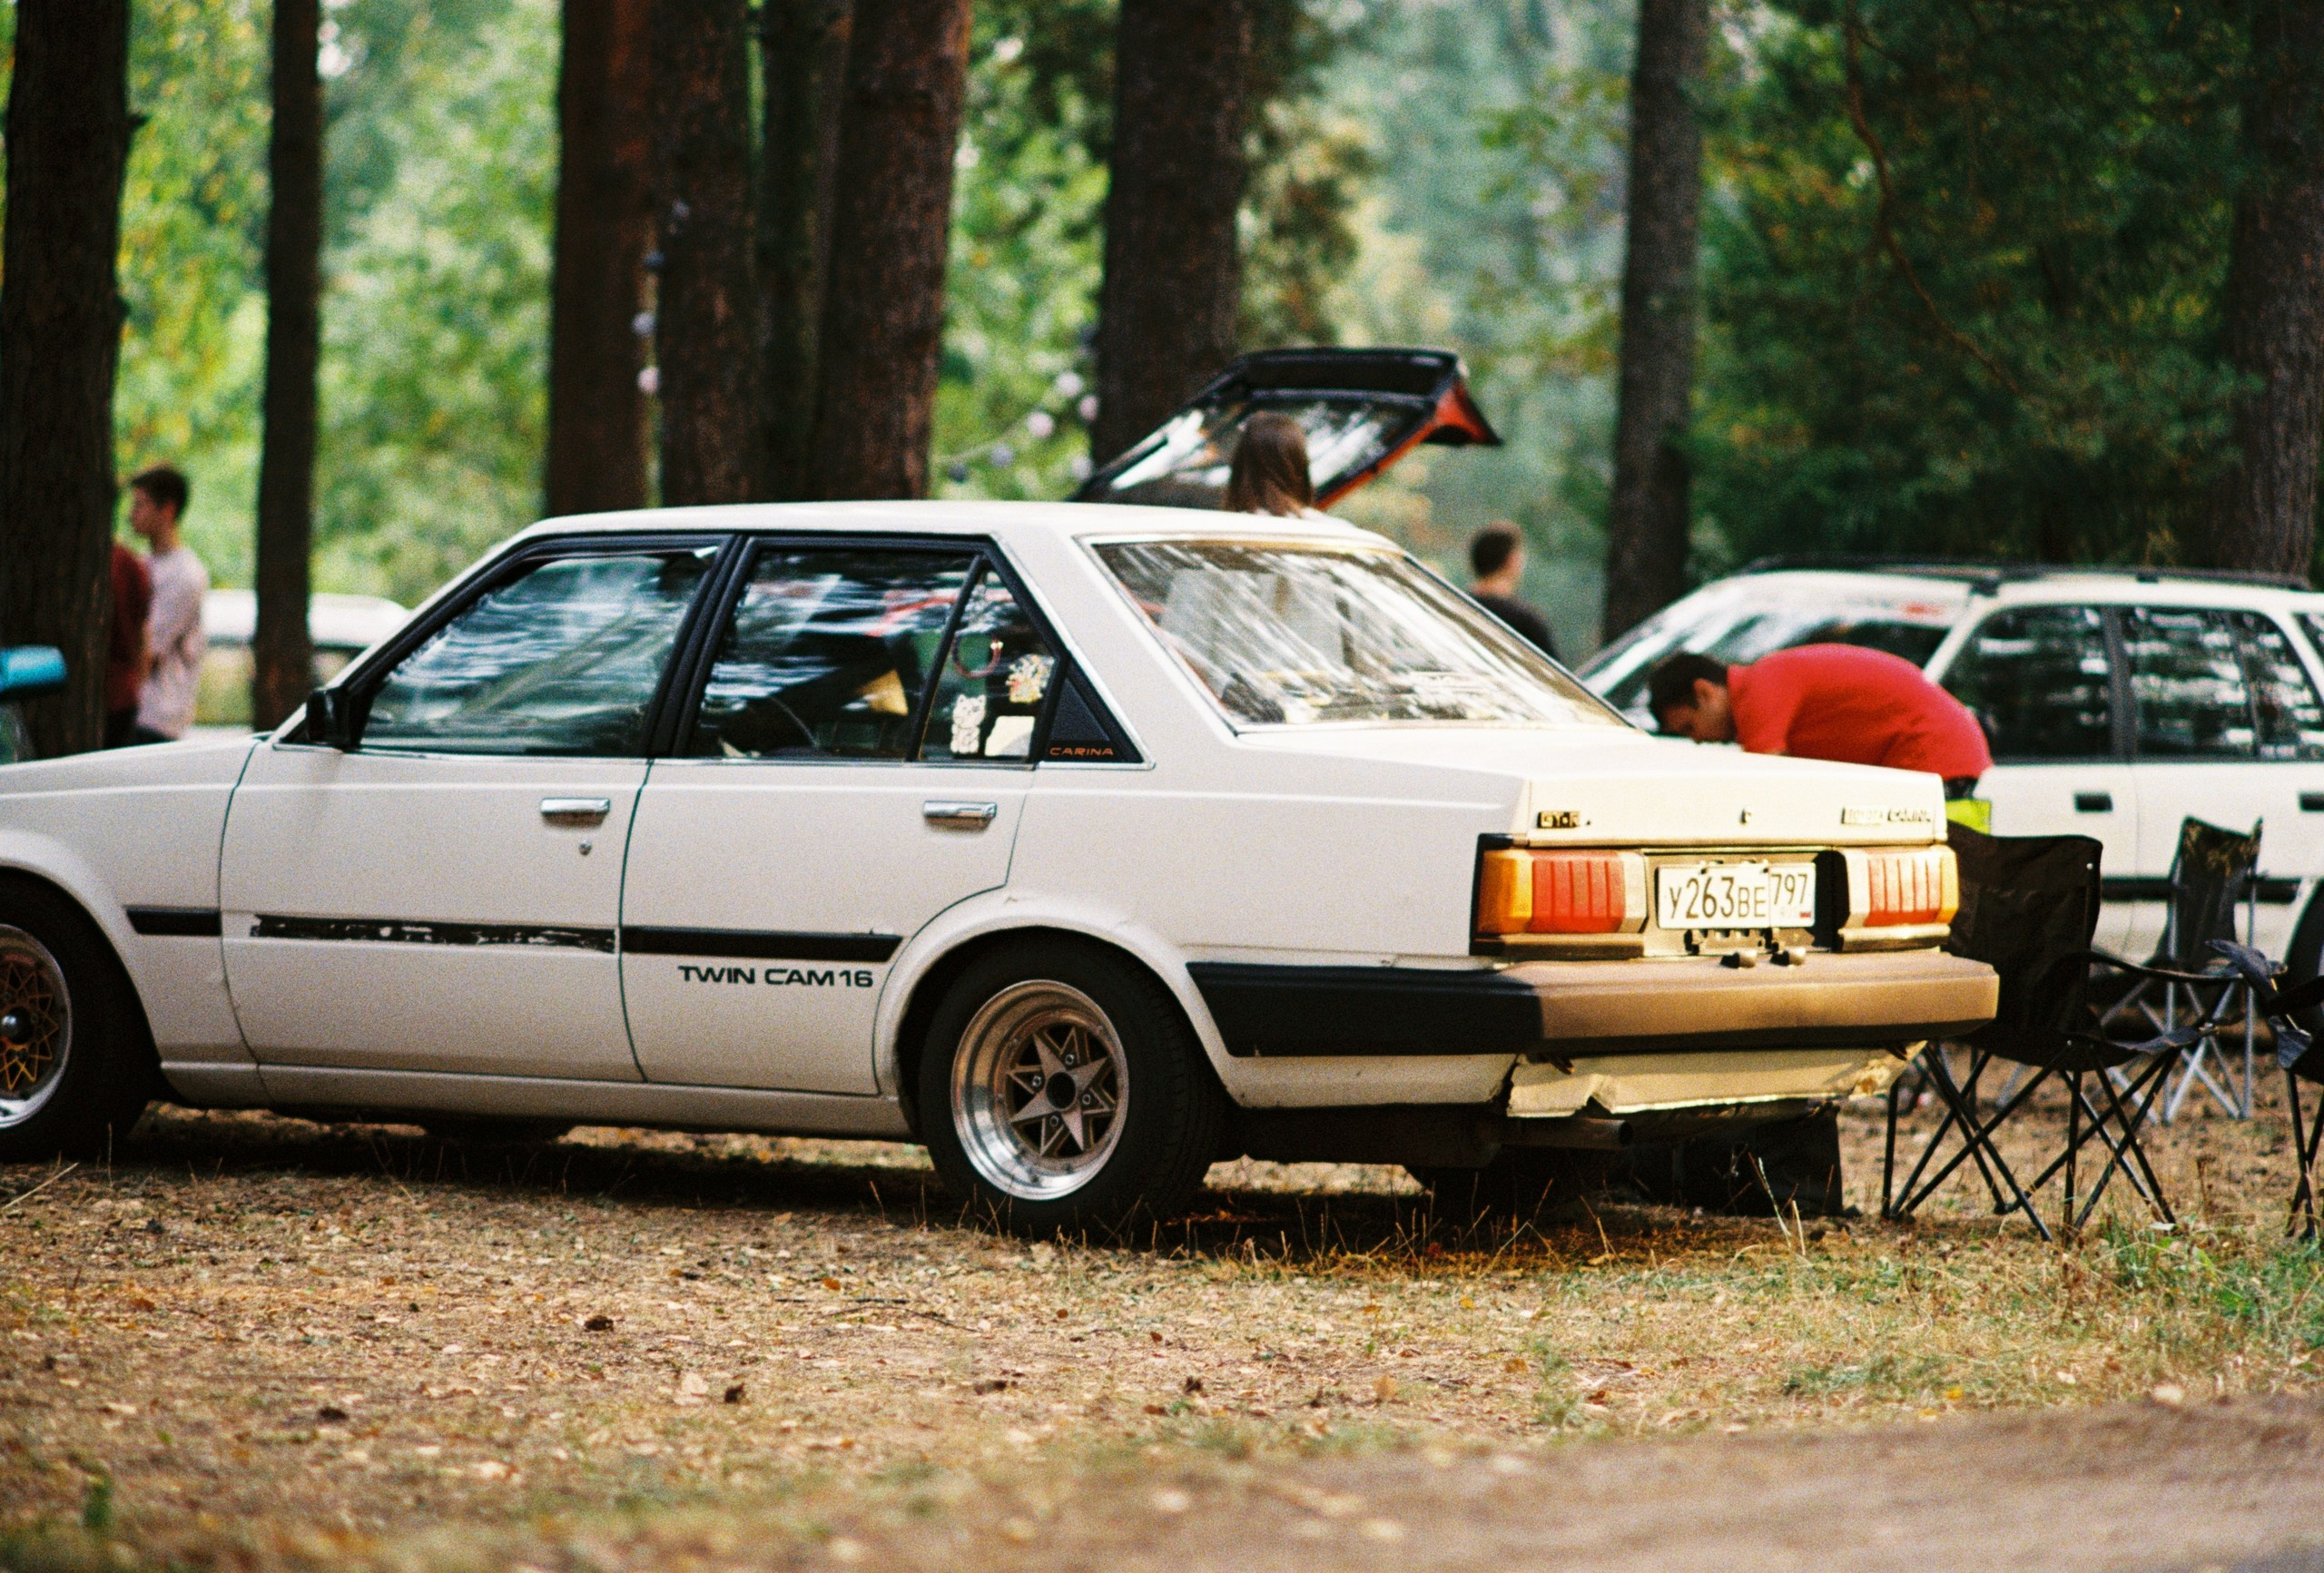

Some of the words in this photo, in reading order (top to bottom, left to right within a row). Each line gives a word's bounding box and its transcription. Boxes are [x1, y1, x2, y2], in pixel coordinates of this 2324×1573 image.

[1049, 747, 1114, 756] CARINA
[1669, 876, 1766, 919] У263ВЕ
[1771, 873, 1808, 905] 797
[677, 965, 755, 985] TWIN
